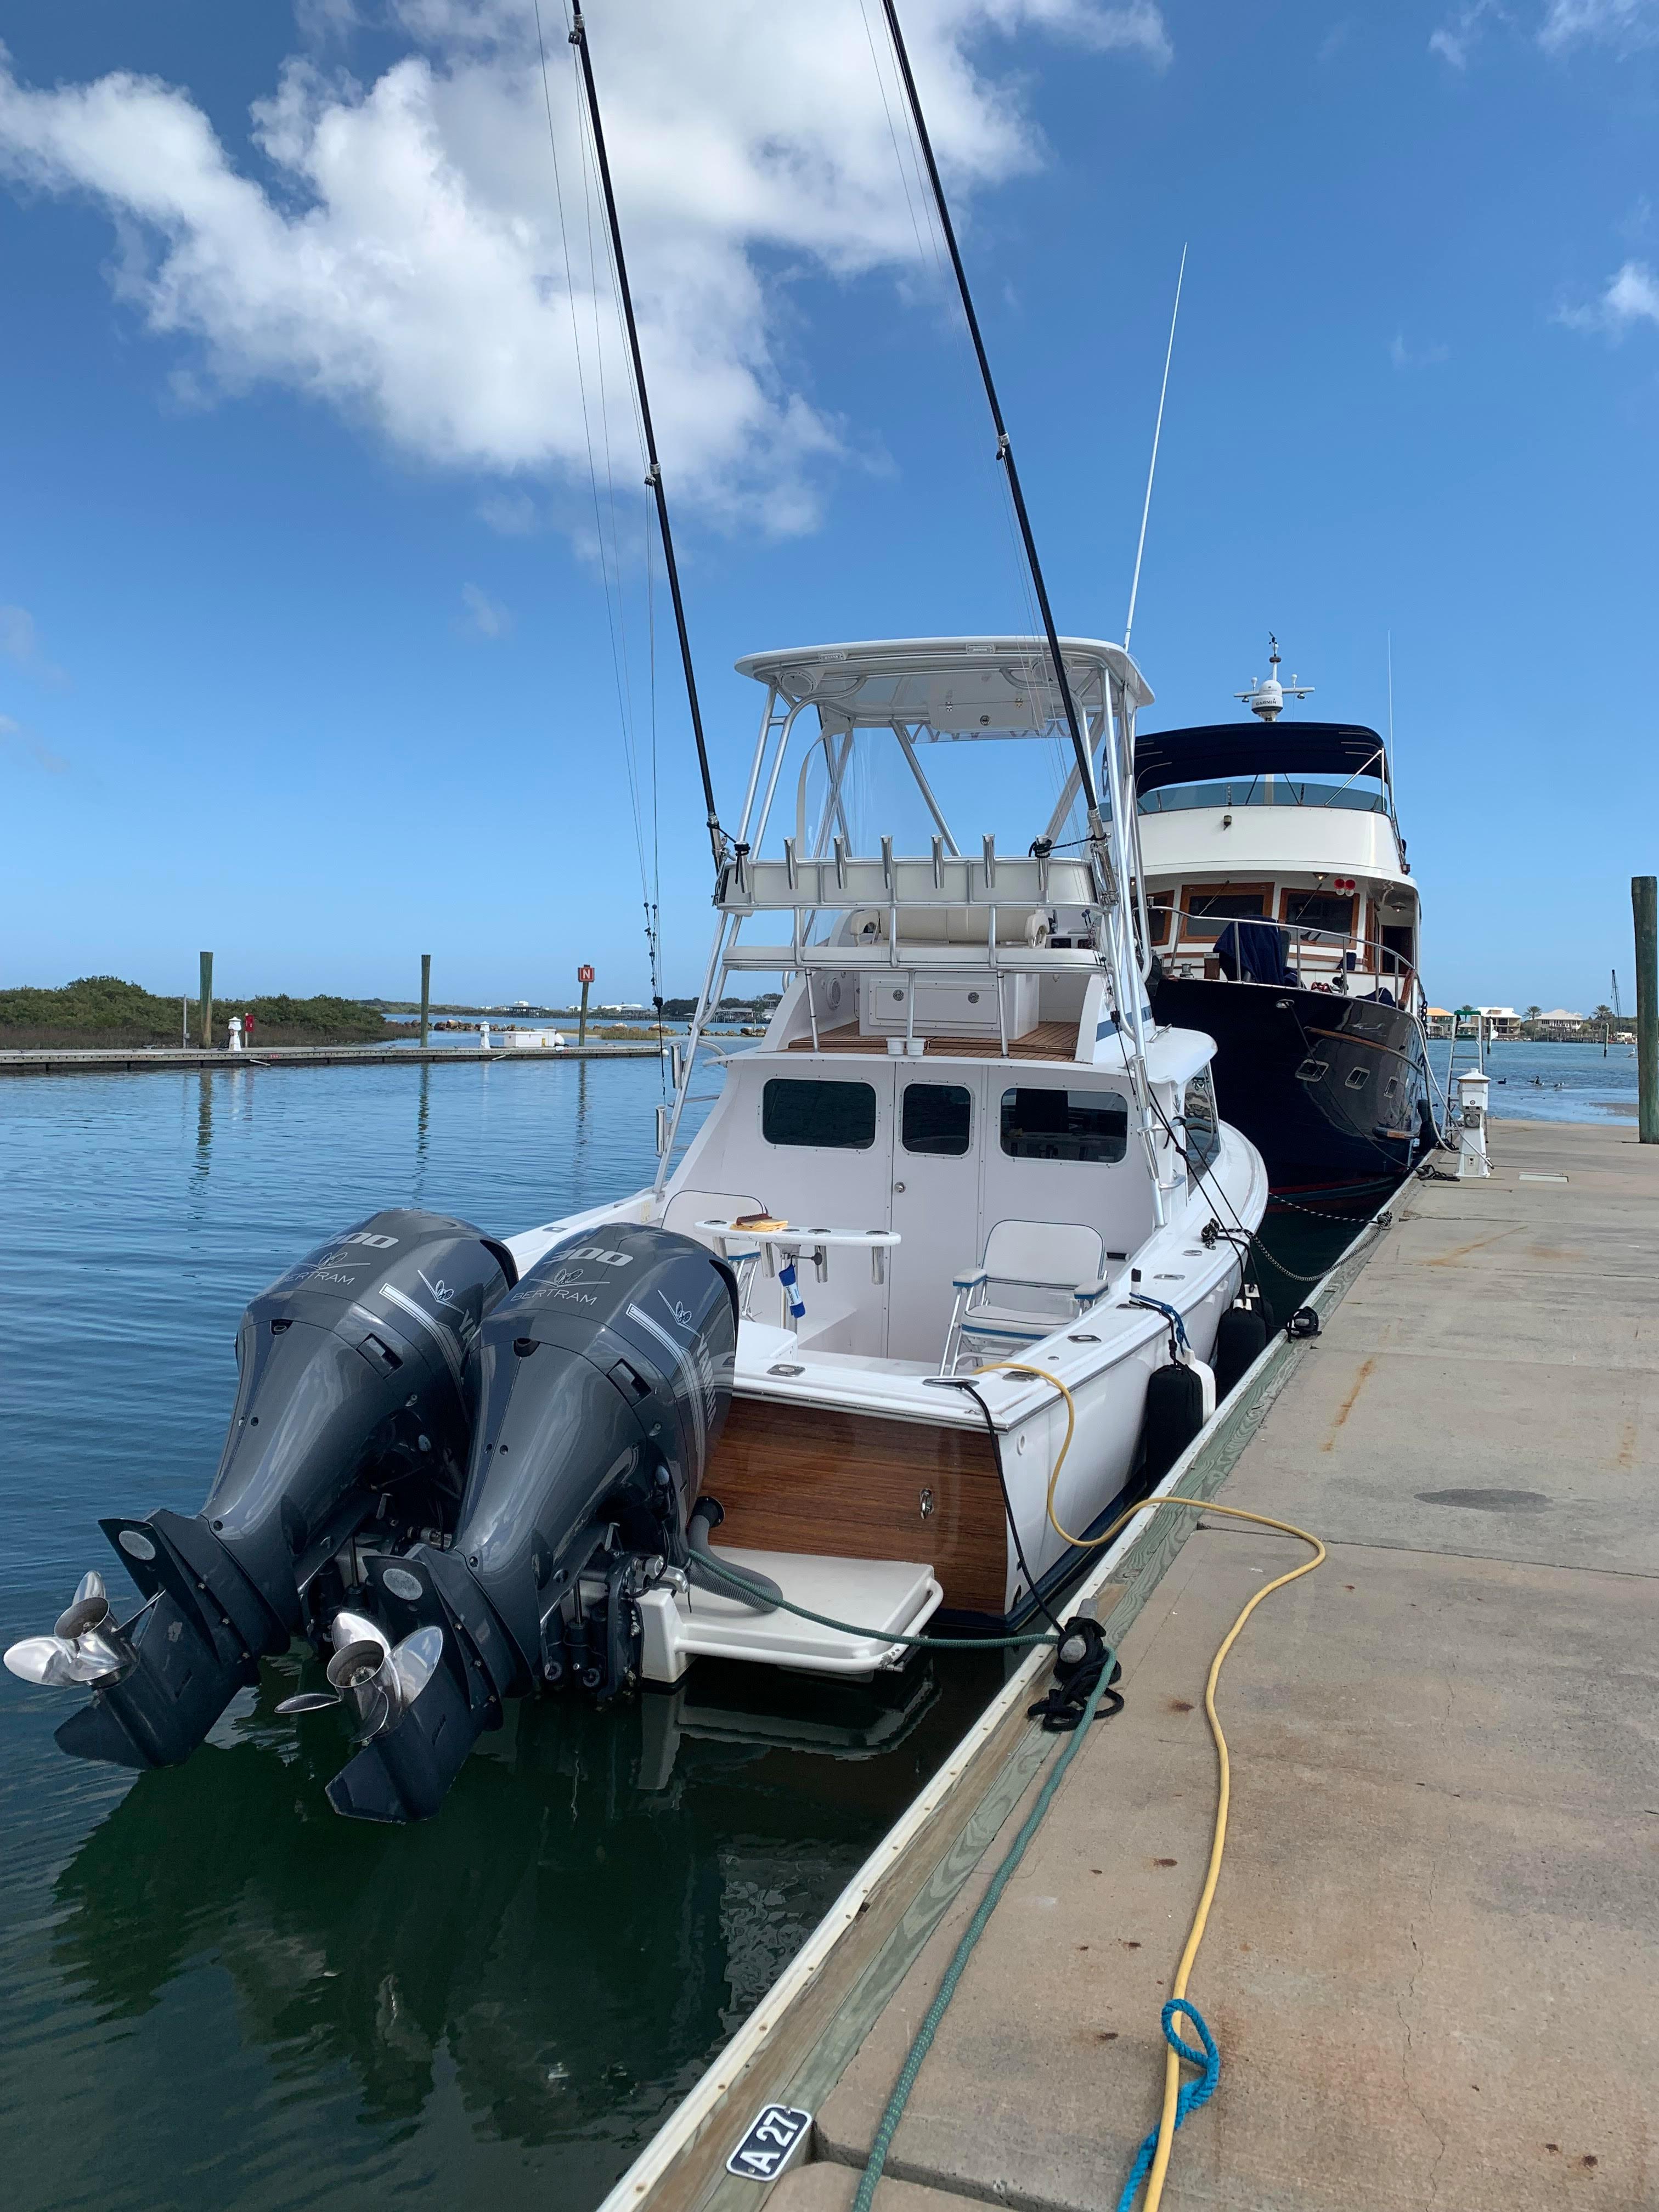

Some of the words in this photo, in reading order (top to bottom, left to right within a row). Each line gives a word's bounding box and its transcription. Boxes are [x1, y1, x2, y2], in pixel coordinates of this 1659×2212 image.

[583, 969, 590, 979] N
[542, 1247, 634, 1266] 300
[510, 1289, 597, 1305] BERTRAM
[697, 1332, 716, 1431] YAMAHA
[756, 2111, 799, 2147] 27
[740, 2151, 781, 2174] A
